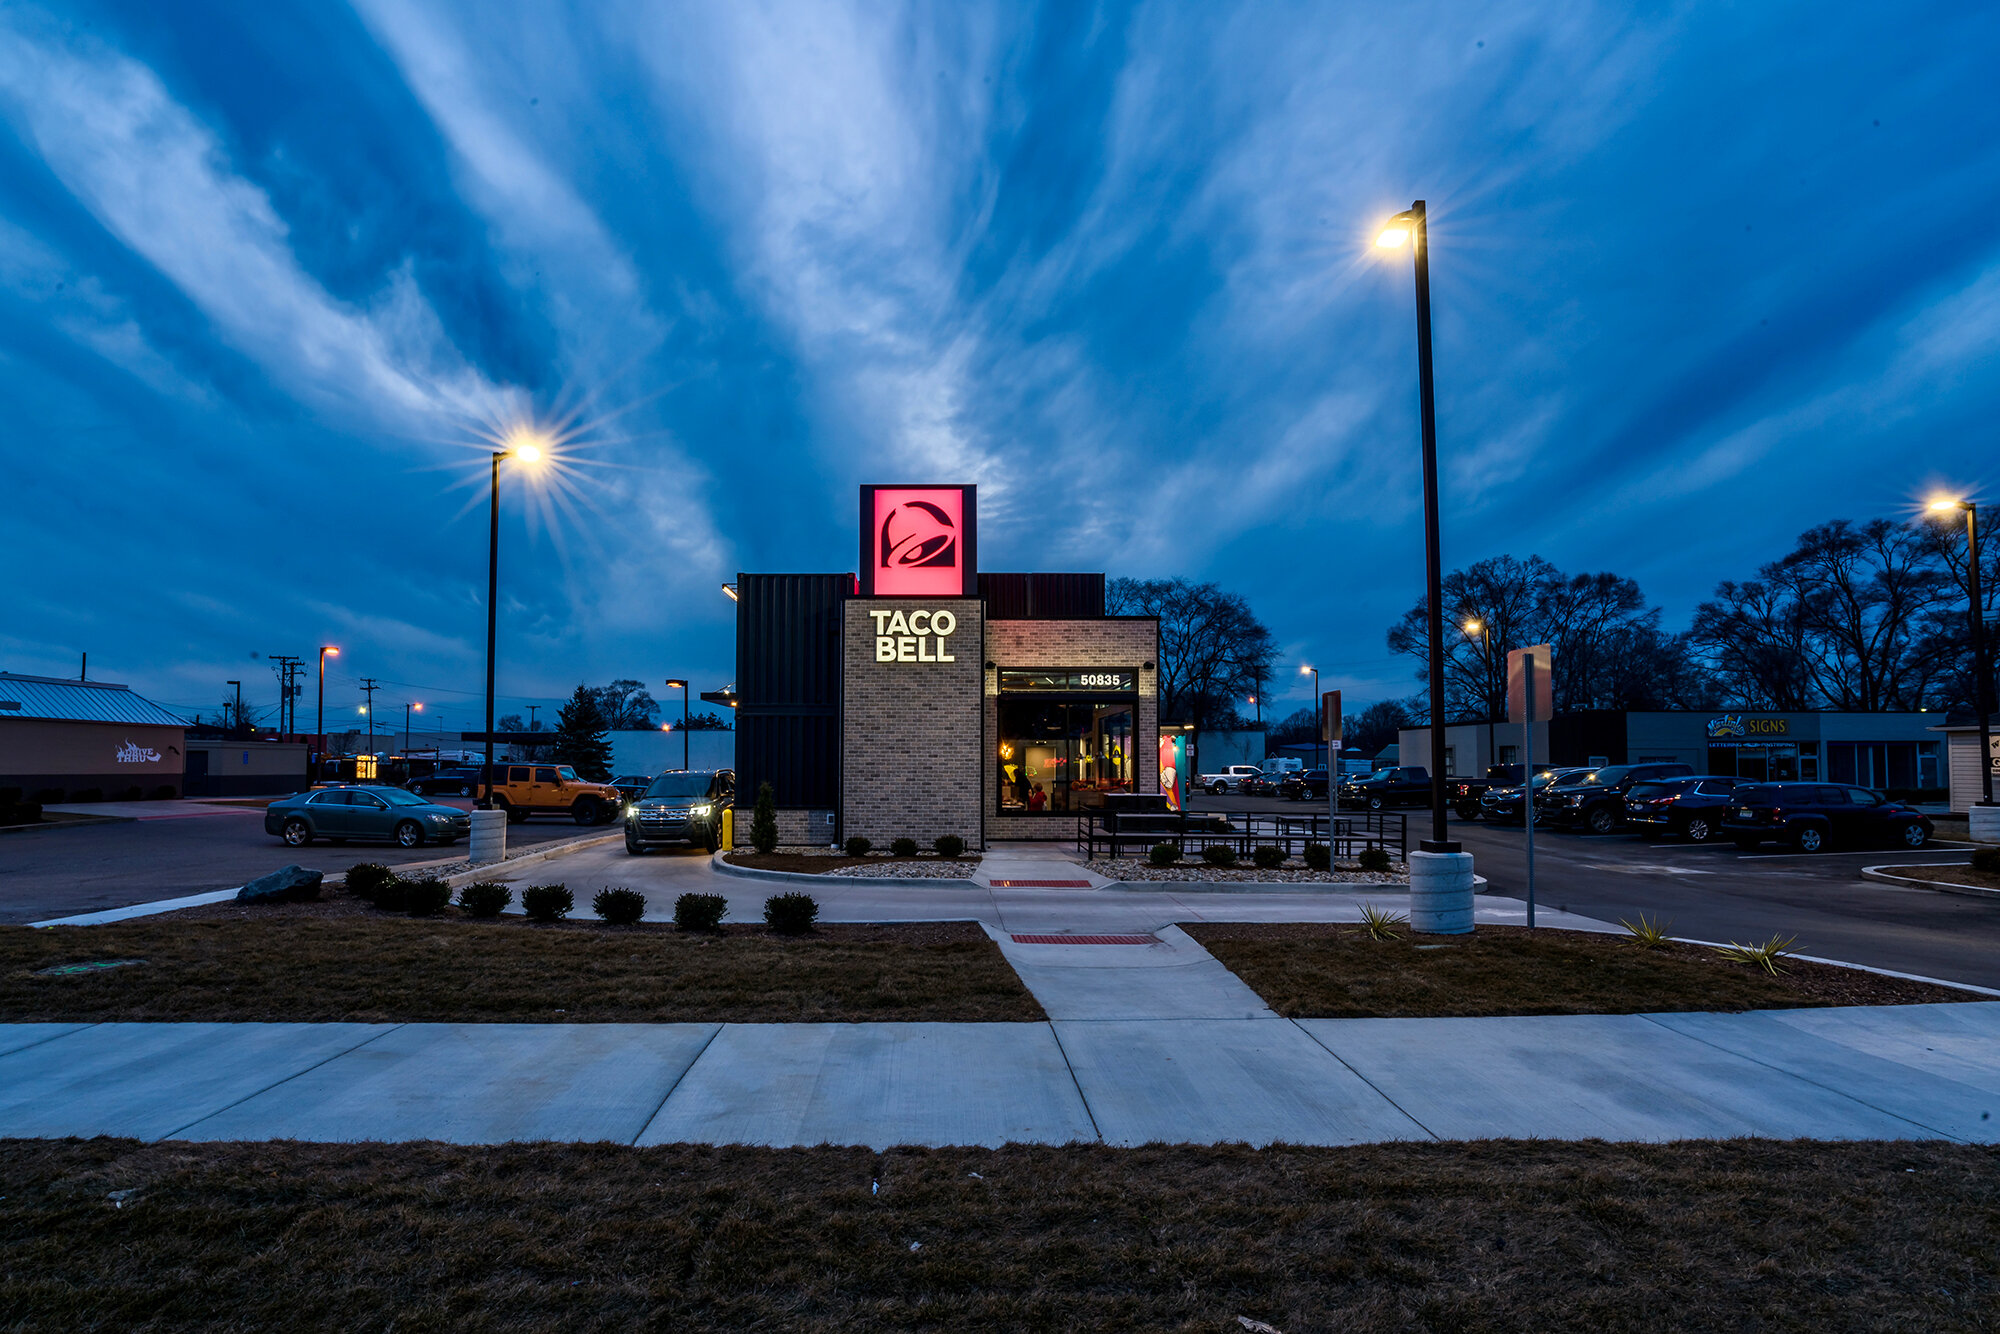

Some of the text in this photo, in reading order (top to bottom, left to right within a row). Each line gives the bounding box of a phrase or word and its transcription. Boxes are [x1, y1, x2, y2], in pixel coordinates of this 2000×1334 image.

[869, 609, 957, 636] TACO
[876, 636, 955, 662] BELL
[1080, 674, 1120, 686] 50835
[1749, 719, 1786, 733] SIGNS
[117, 752, 146, 763] THRU
[125, 747, 154, 756] DRIVE
